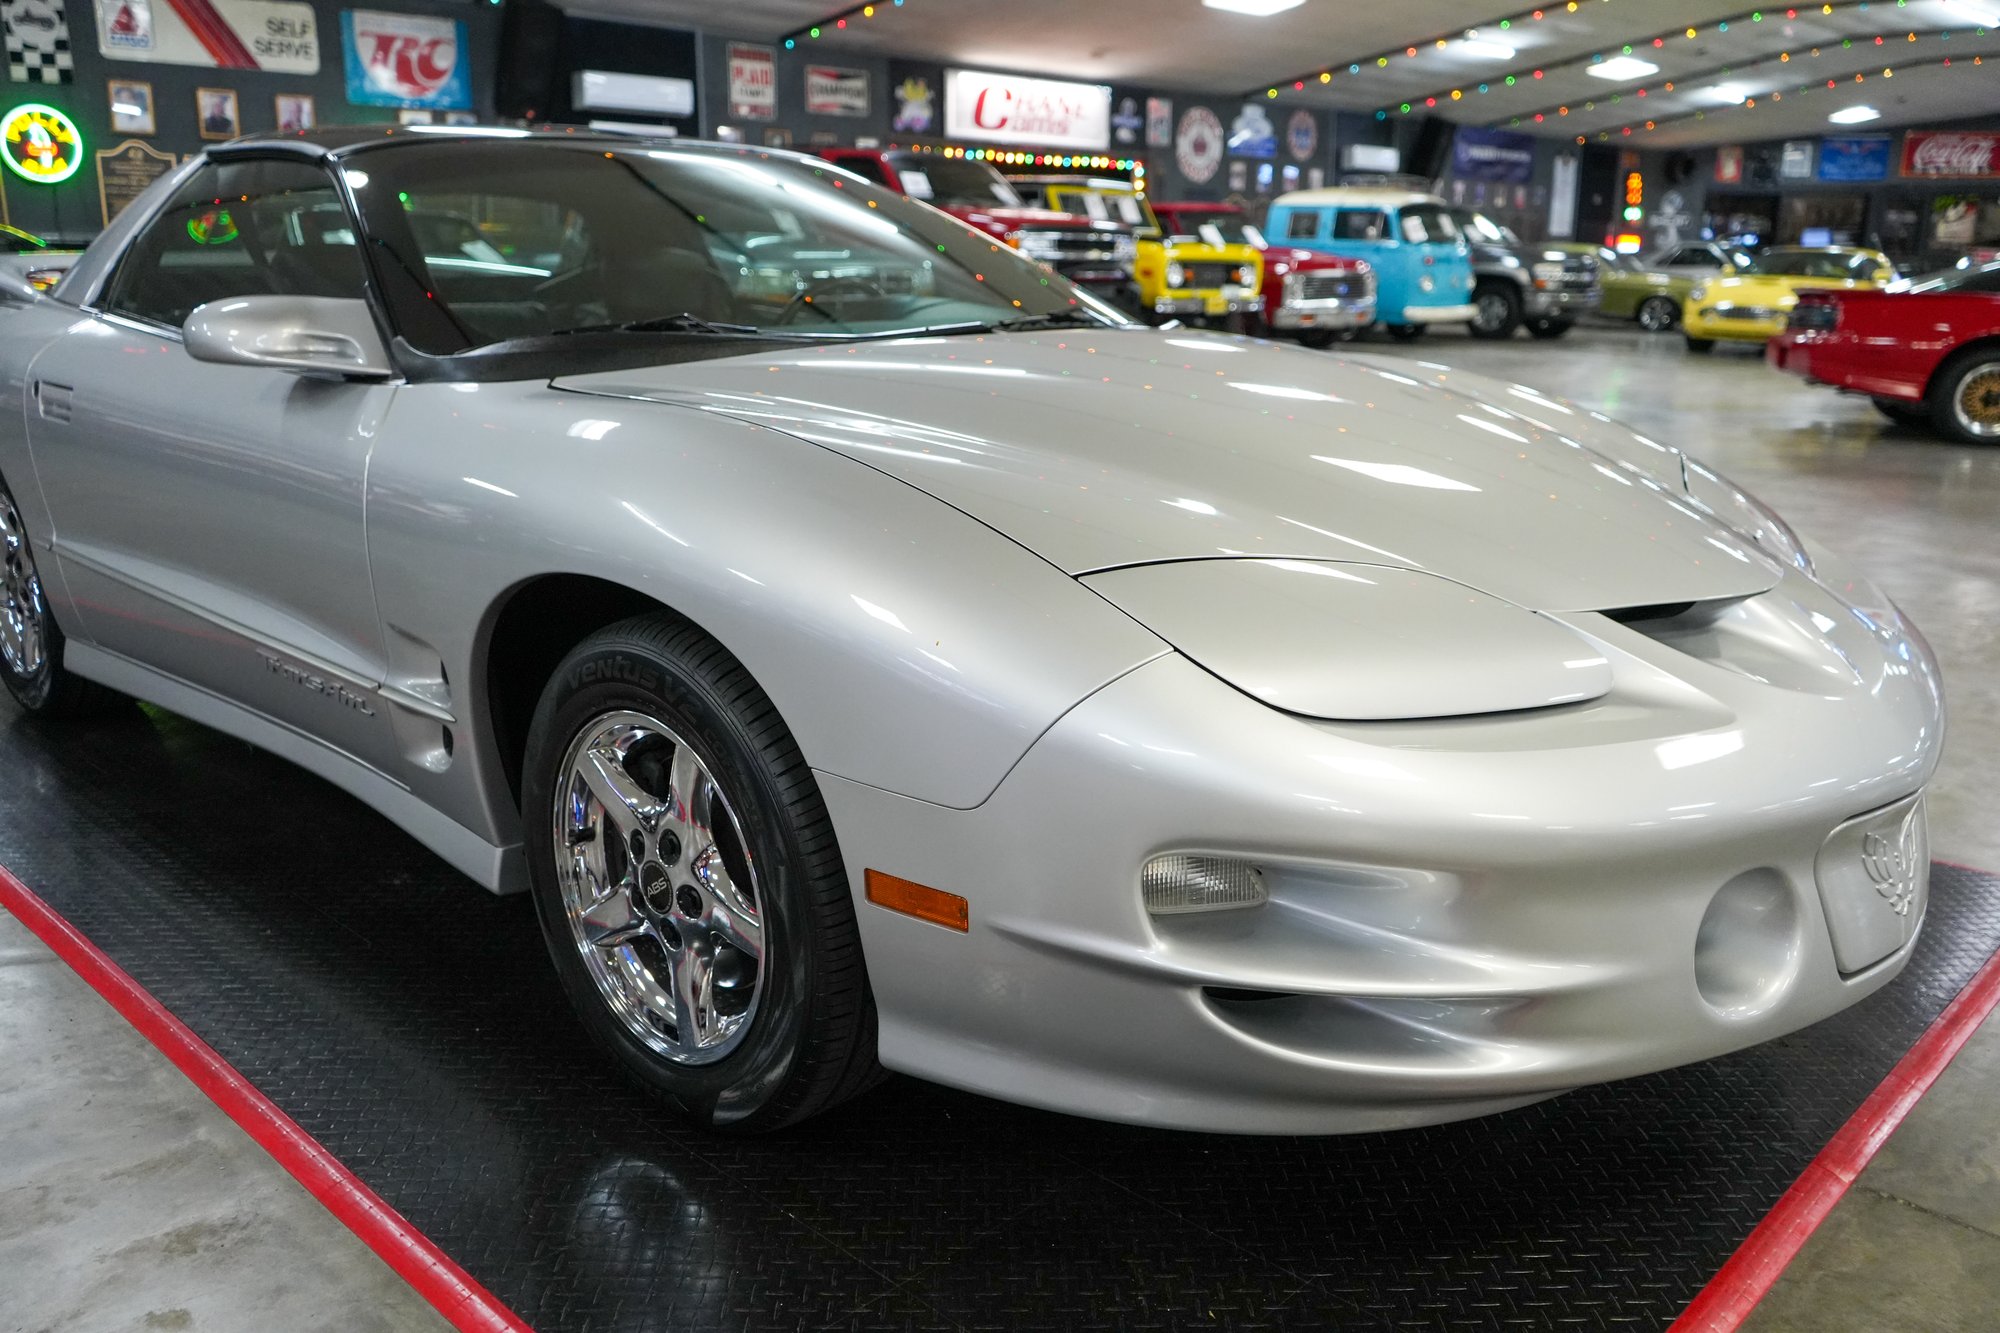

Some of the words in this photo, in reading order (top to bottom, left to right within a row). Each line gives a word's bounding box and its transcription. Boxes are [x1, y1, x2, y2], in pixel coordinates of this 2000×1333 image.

[265, 16, 311, 38] SELF
[253, 38, 314, 59] SERVE
[647, 876, 668, 899] ABS
